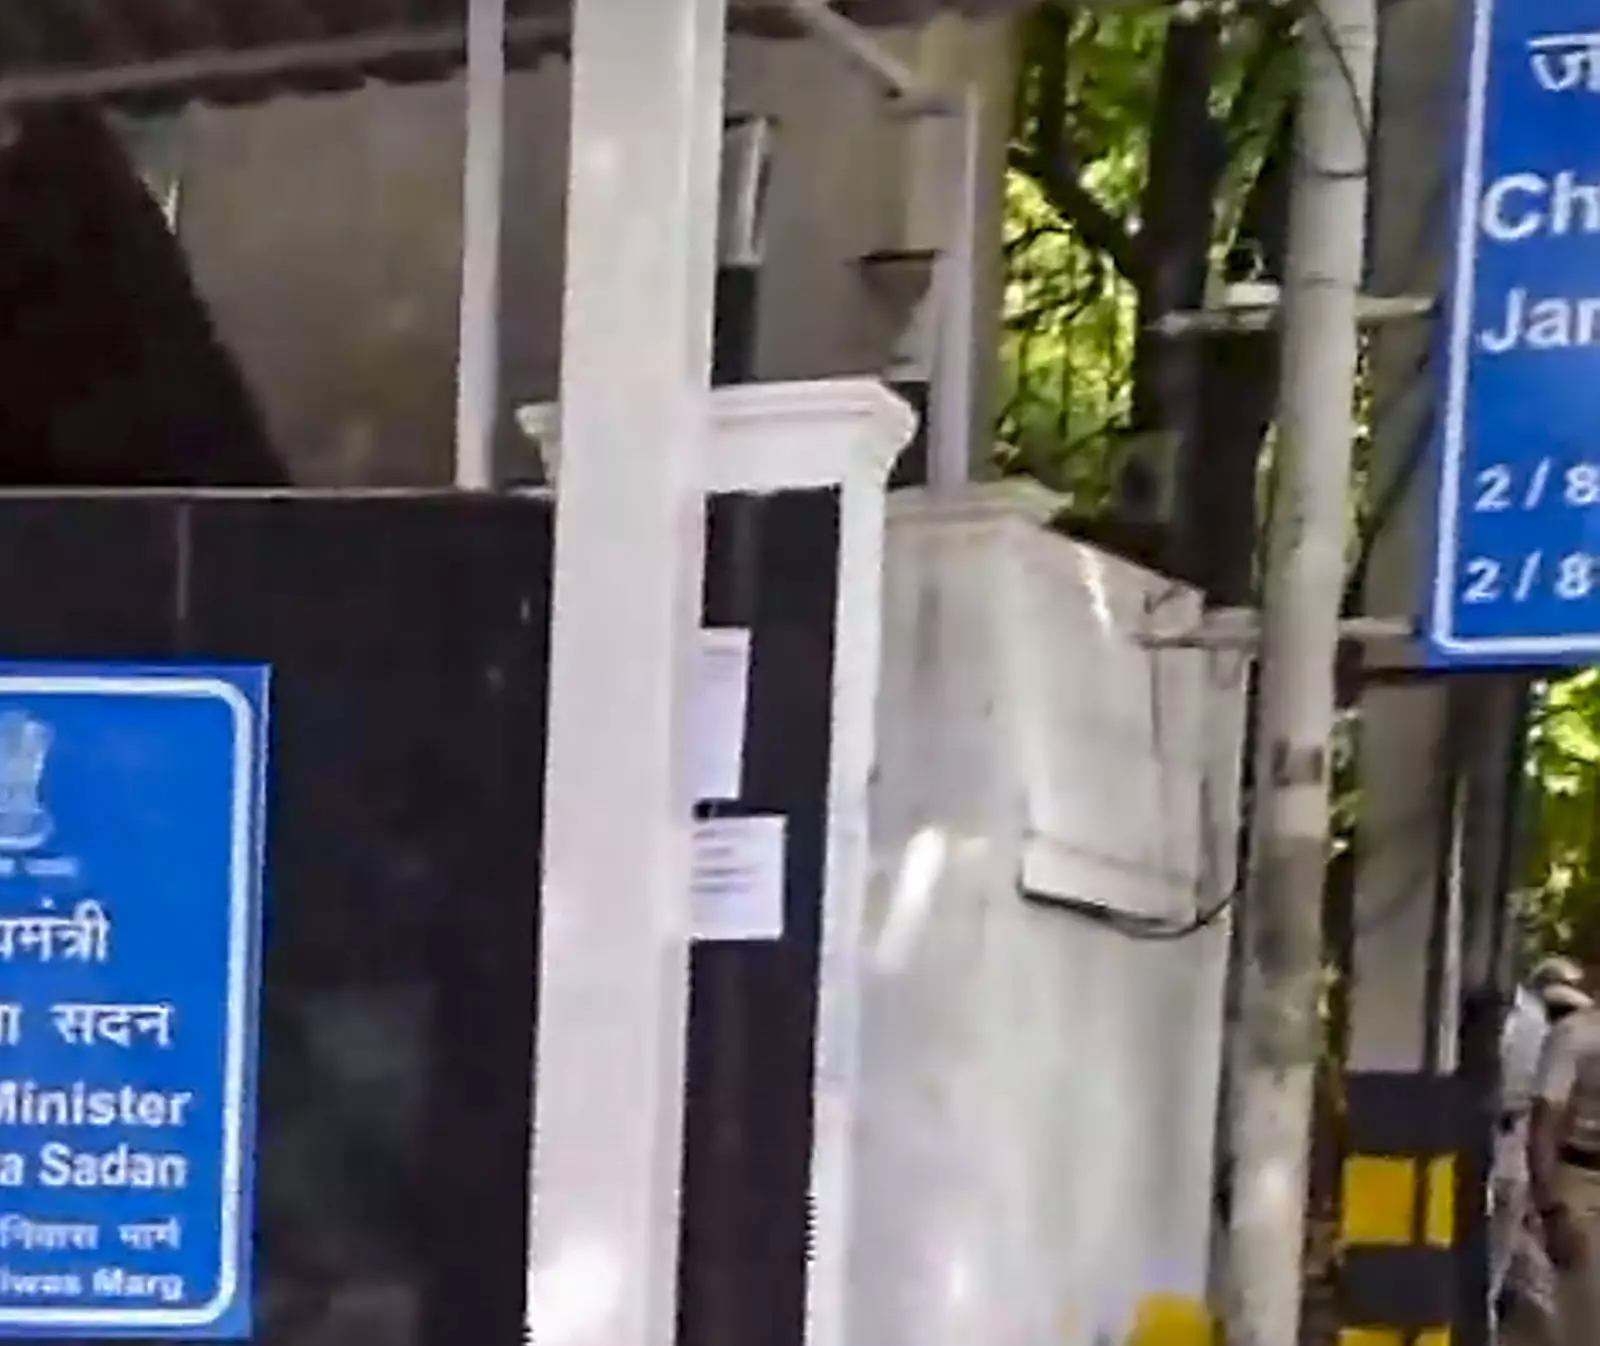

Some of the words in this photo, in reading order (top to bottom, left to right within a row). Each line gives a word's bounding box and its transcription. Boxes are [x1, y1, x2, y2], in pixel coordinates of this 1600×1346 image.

[1474, 462, 1512, 512] 2
[1563, 463, 1600, 507] 8
[1462, 555, 1501, 604] 2
[1552, 552, 1593, 601] 8
[50, 1000, 175, 1048] सदन
[38, 1140, 188, 1188] Sadan
[92, 1265, 185, 1302] Marg
